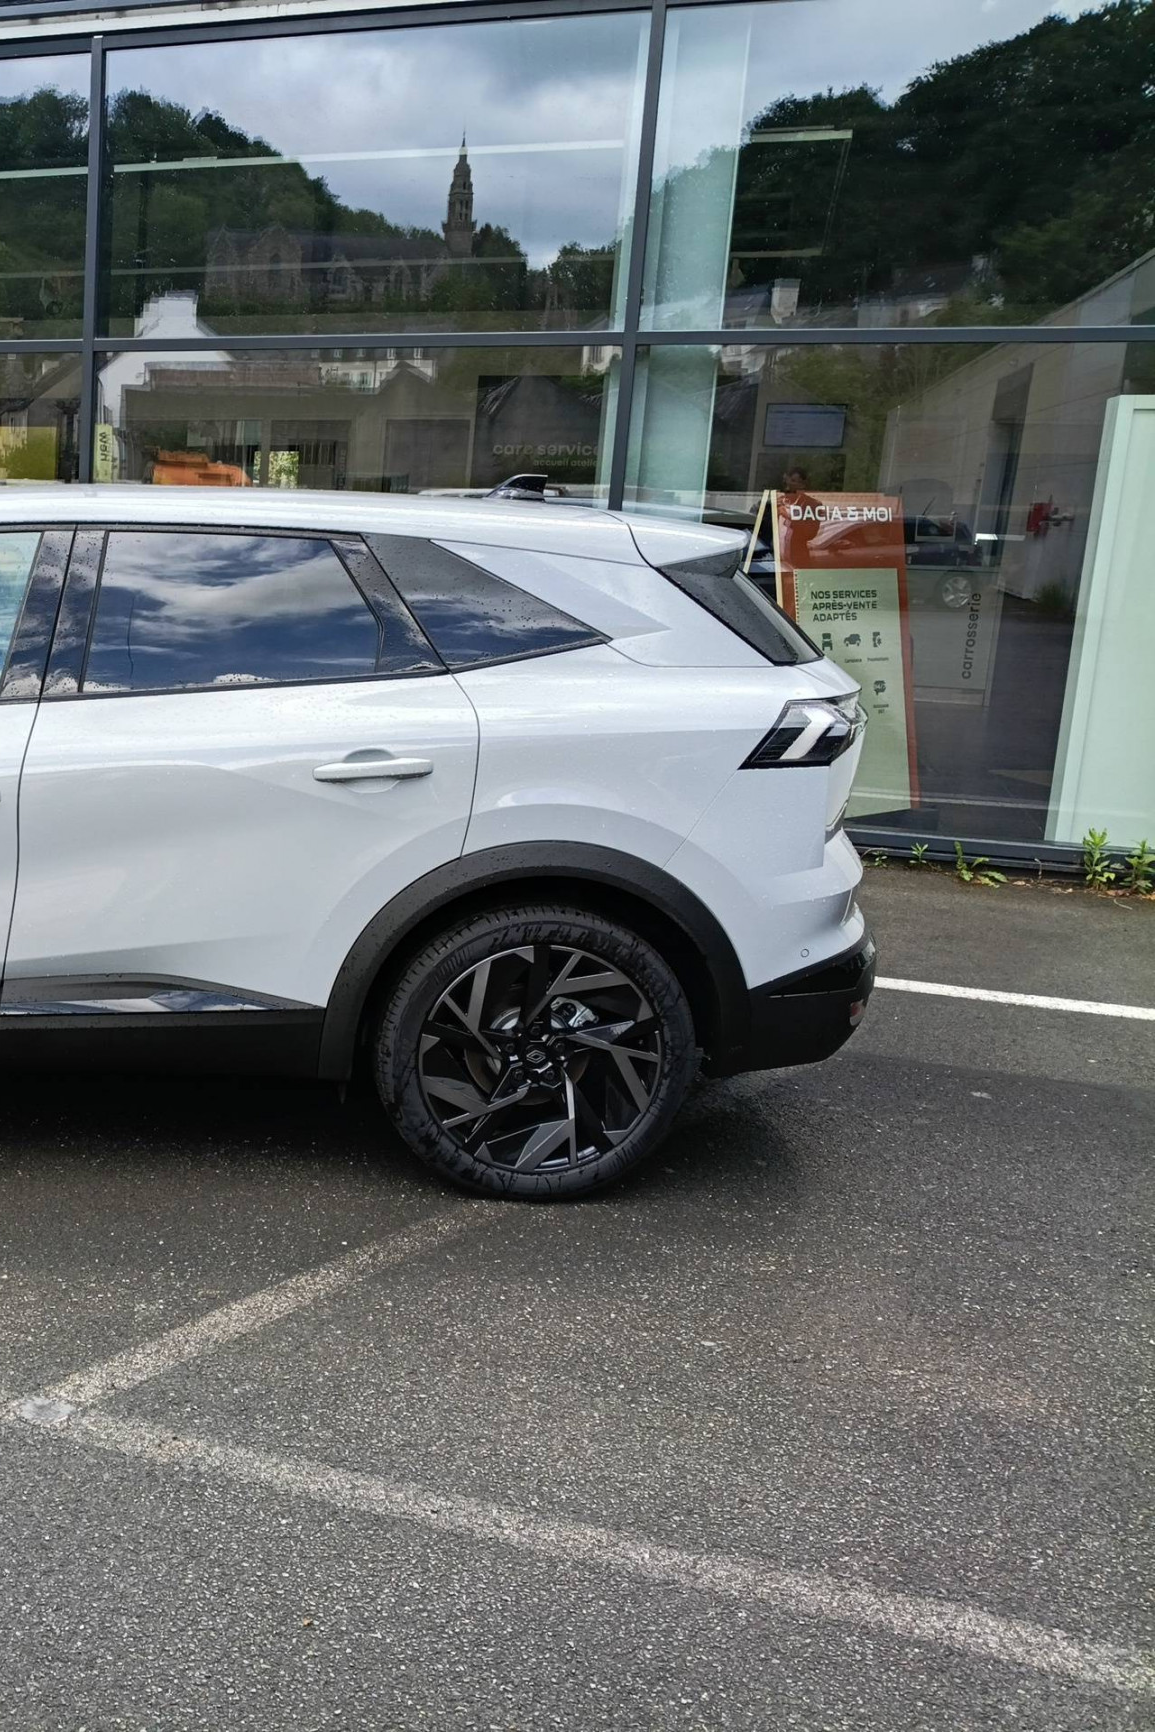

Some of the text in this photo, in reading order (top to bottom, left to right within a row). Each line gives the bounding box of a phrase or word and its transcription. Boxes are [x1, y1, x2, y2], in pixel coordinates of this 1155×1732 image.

[492, 443, 534, 456] care
[790, 505, 893, 522] DACIA & MOI
[810, 589, 877, 599] NOS SERVICES
[812, 600, 878, 611] APRÈS-VENTE
[812, 610, 858, 622] ADAPTÉS
[961, 592, 982, 680] carrosserie
